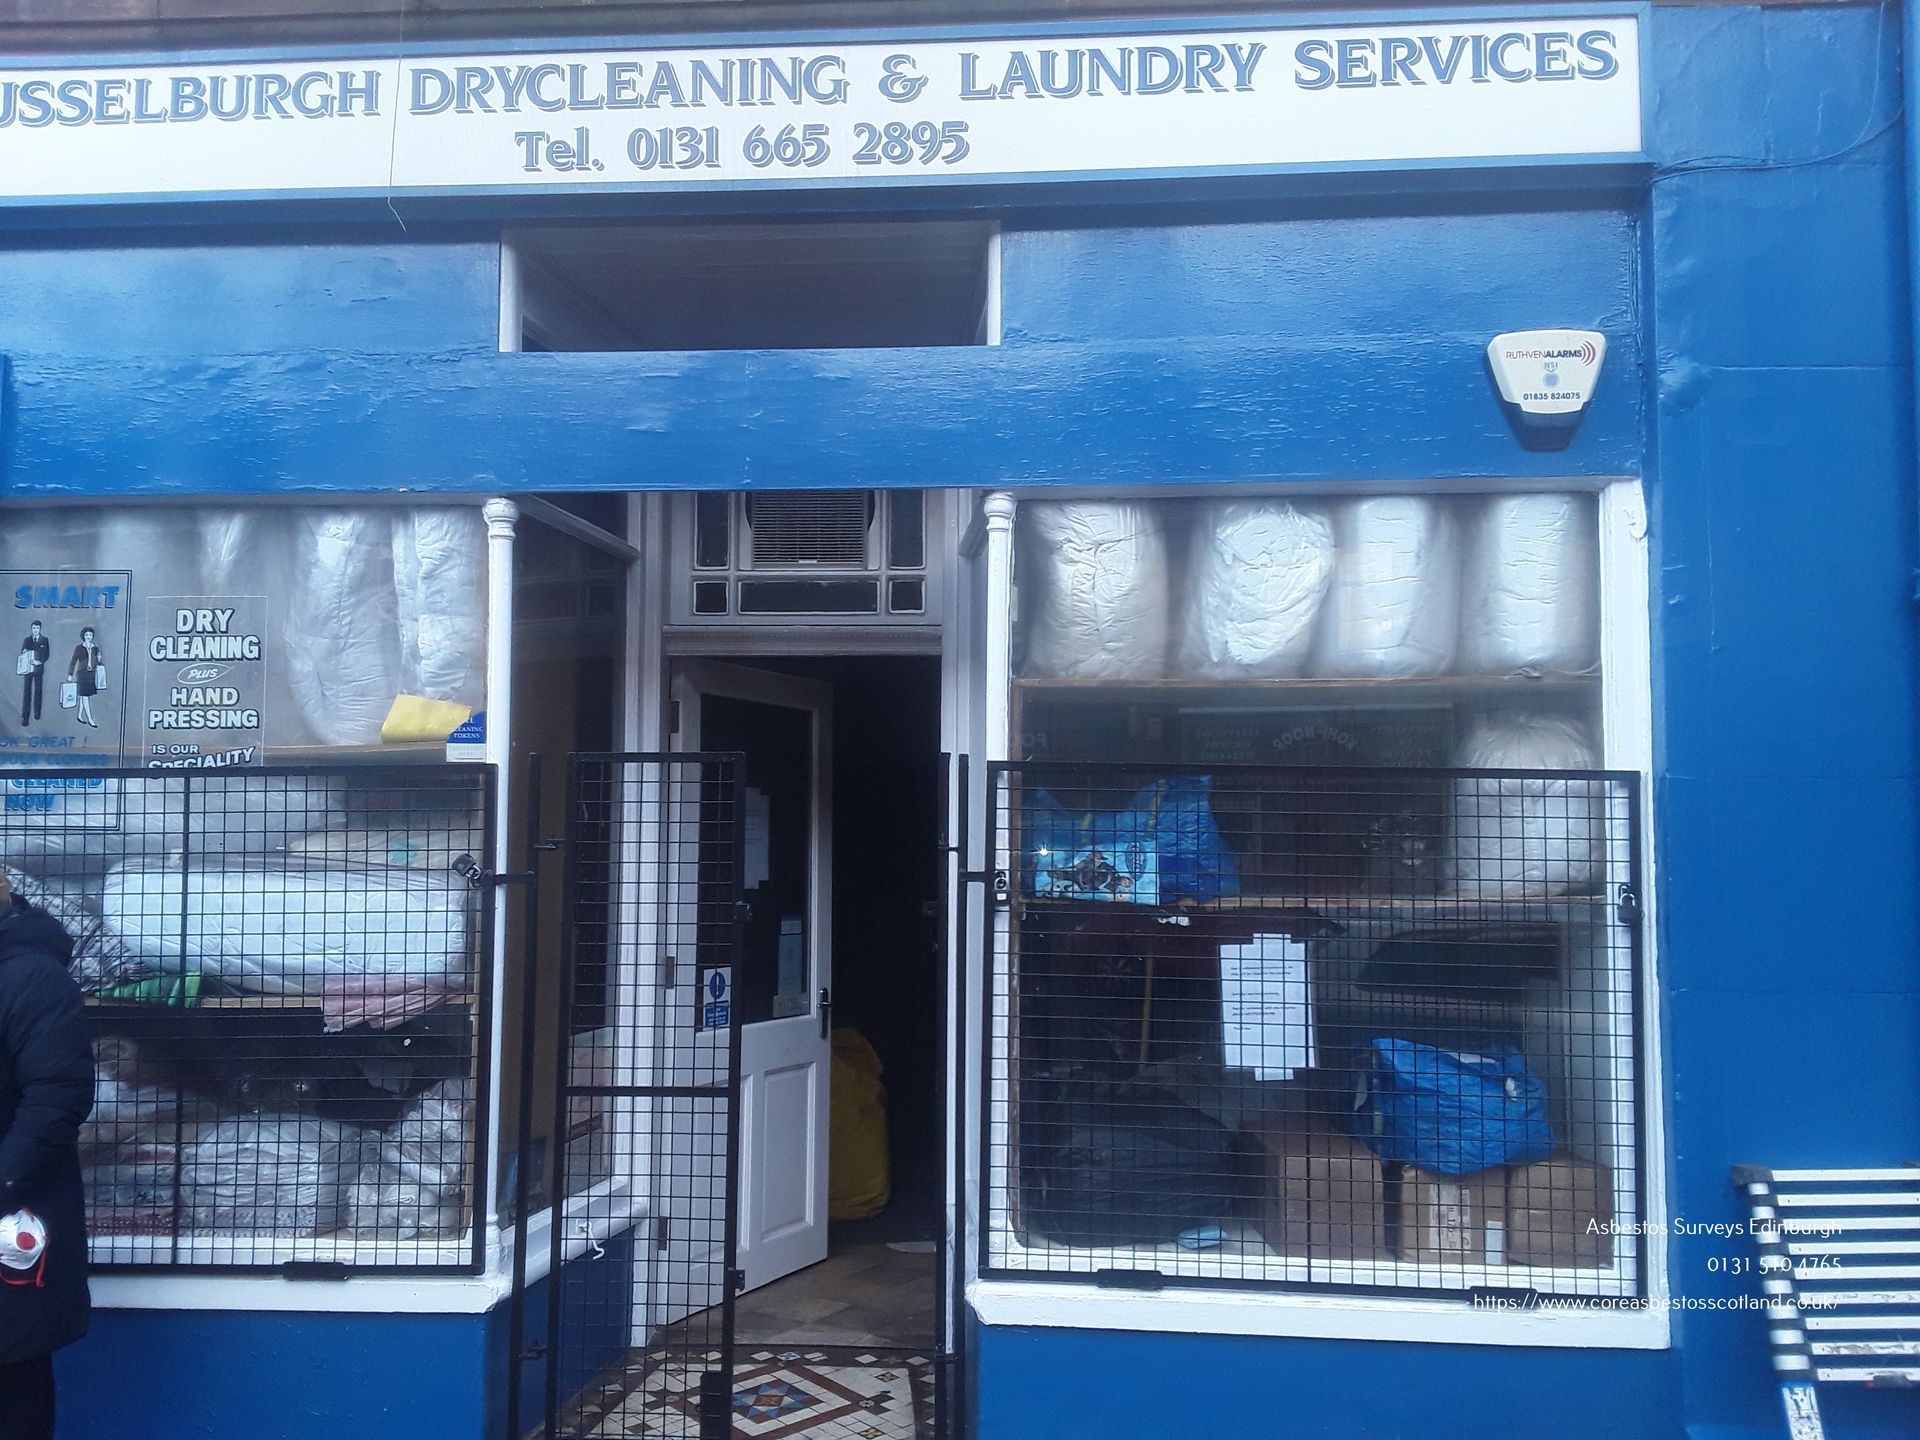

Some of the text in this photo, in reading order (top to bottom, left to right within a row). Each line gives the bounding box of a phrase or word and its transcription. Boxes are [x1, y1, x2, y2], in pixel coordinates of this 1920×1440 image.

[409, 54, 851, 115] DRYCLEANING
[877, 53, 929, 101] &
[958, 42, 1267, 101] LAUNDRY
[1293, 30, 1619, 89] SERVICES
[514, 120, 971, 172] Tel. 0131 665 2895
[1505, 349, 1583, 360] RUTHVENALARMS
[1523, 392, 1581, 401] 01835 824075
[15, 585, 119, 609] SMART
[176, 608, 235, 634] DRY
[149, 635, 261, 662] CLEANING
[187, 667, 219, 680] PLUS
[170, 687, 240, 707] HAND
[148, 708, 260, 730] PRESSING
[152, 744, 200, 755] IS OUR
[5, 793, 55, 812] NOW
